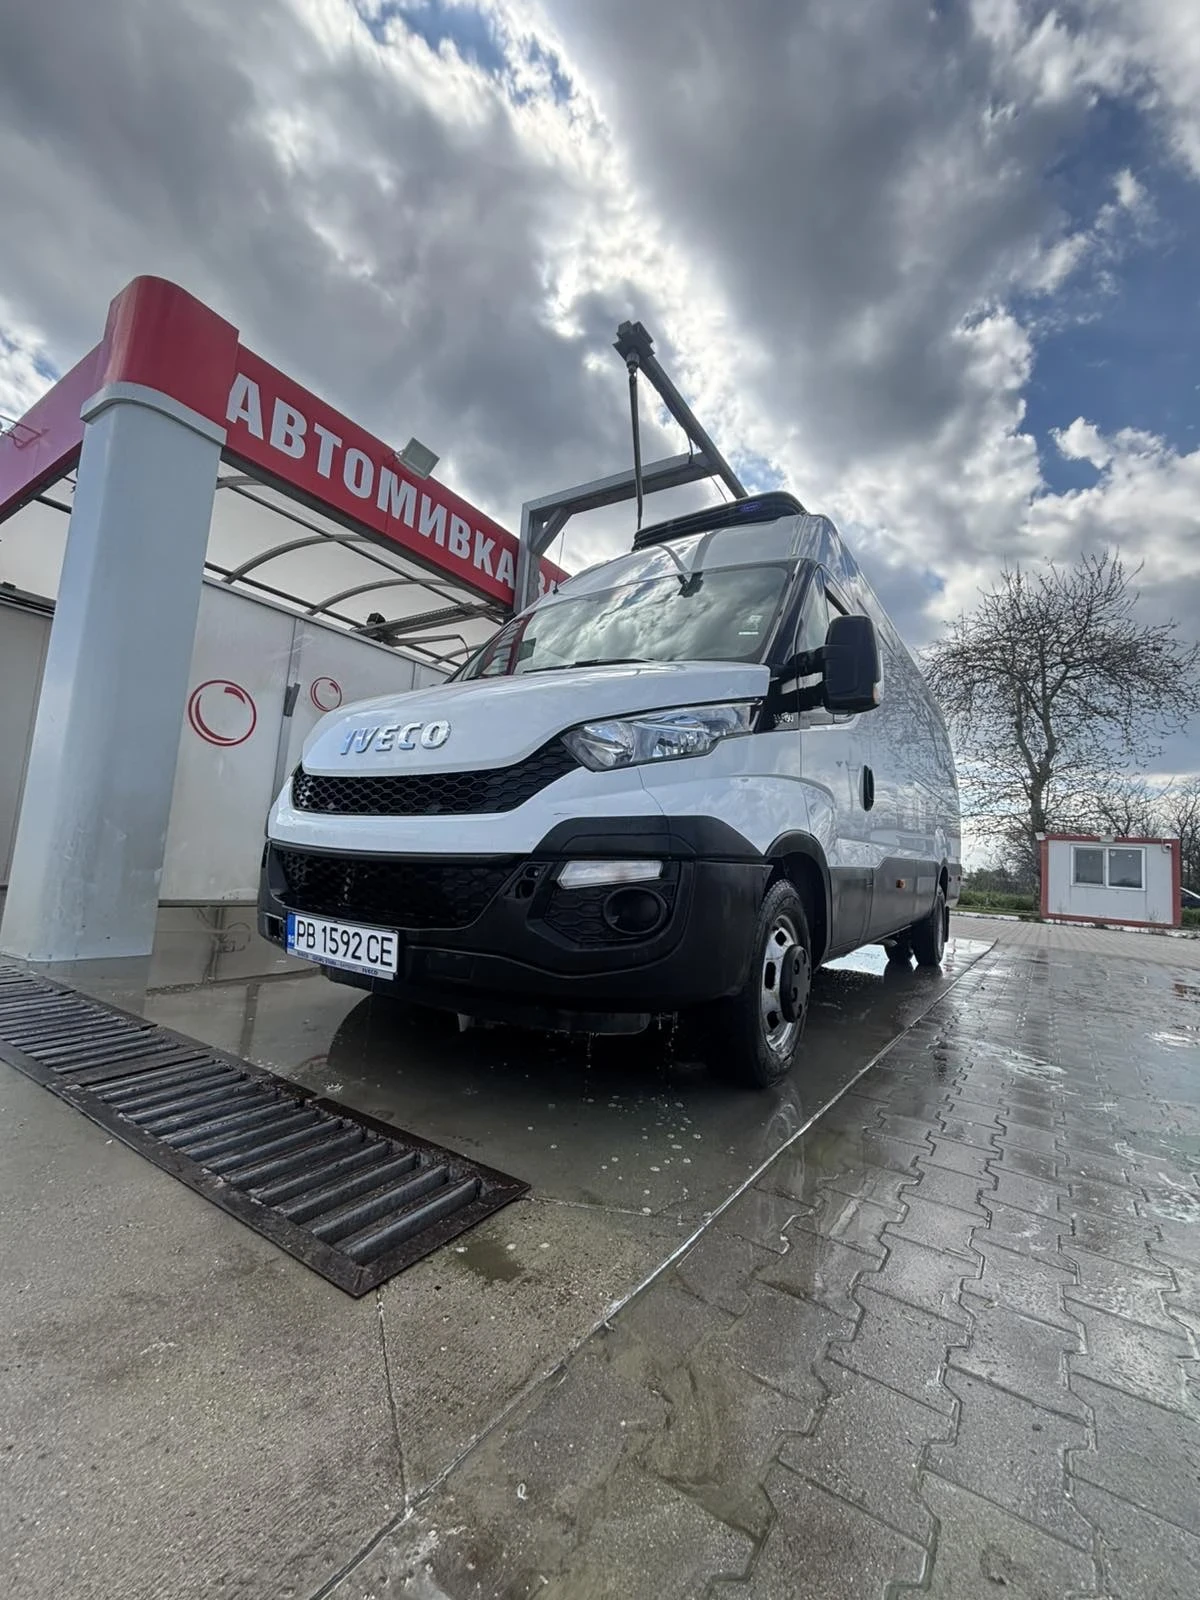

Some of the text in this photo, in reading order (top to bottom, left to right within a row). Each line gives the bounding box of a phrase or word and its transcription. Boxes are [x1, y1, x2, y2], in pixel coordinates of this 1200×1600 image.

[226, 373, 516, 590] АВТОМИВКА
[340, 720, 451, 755] IVECO
[297, 920, 316, 949] PB
[321, 925, 363, 960] 1592
[367, 934, 393, 967] CE
